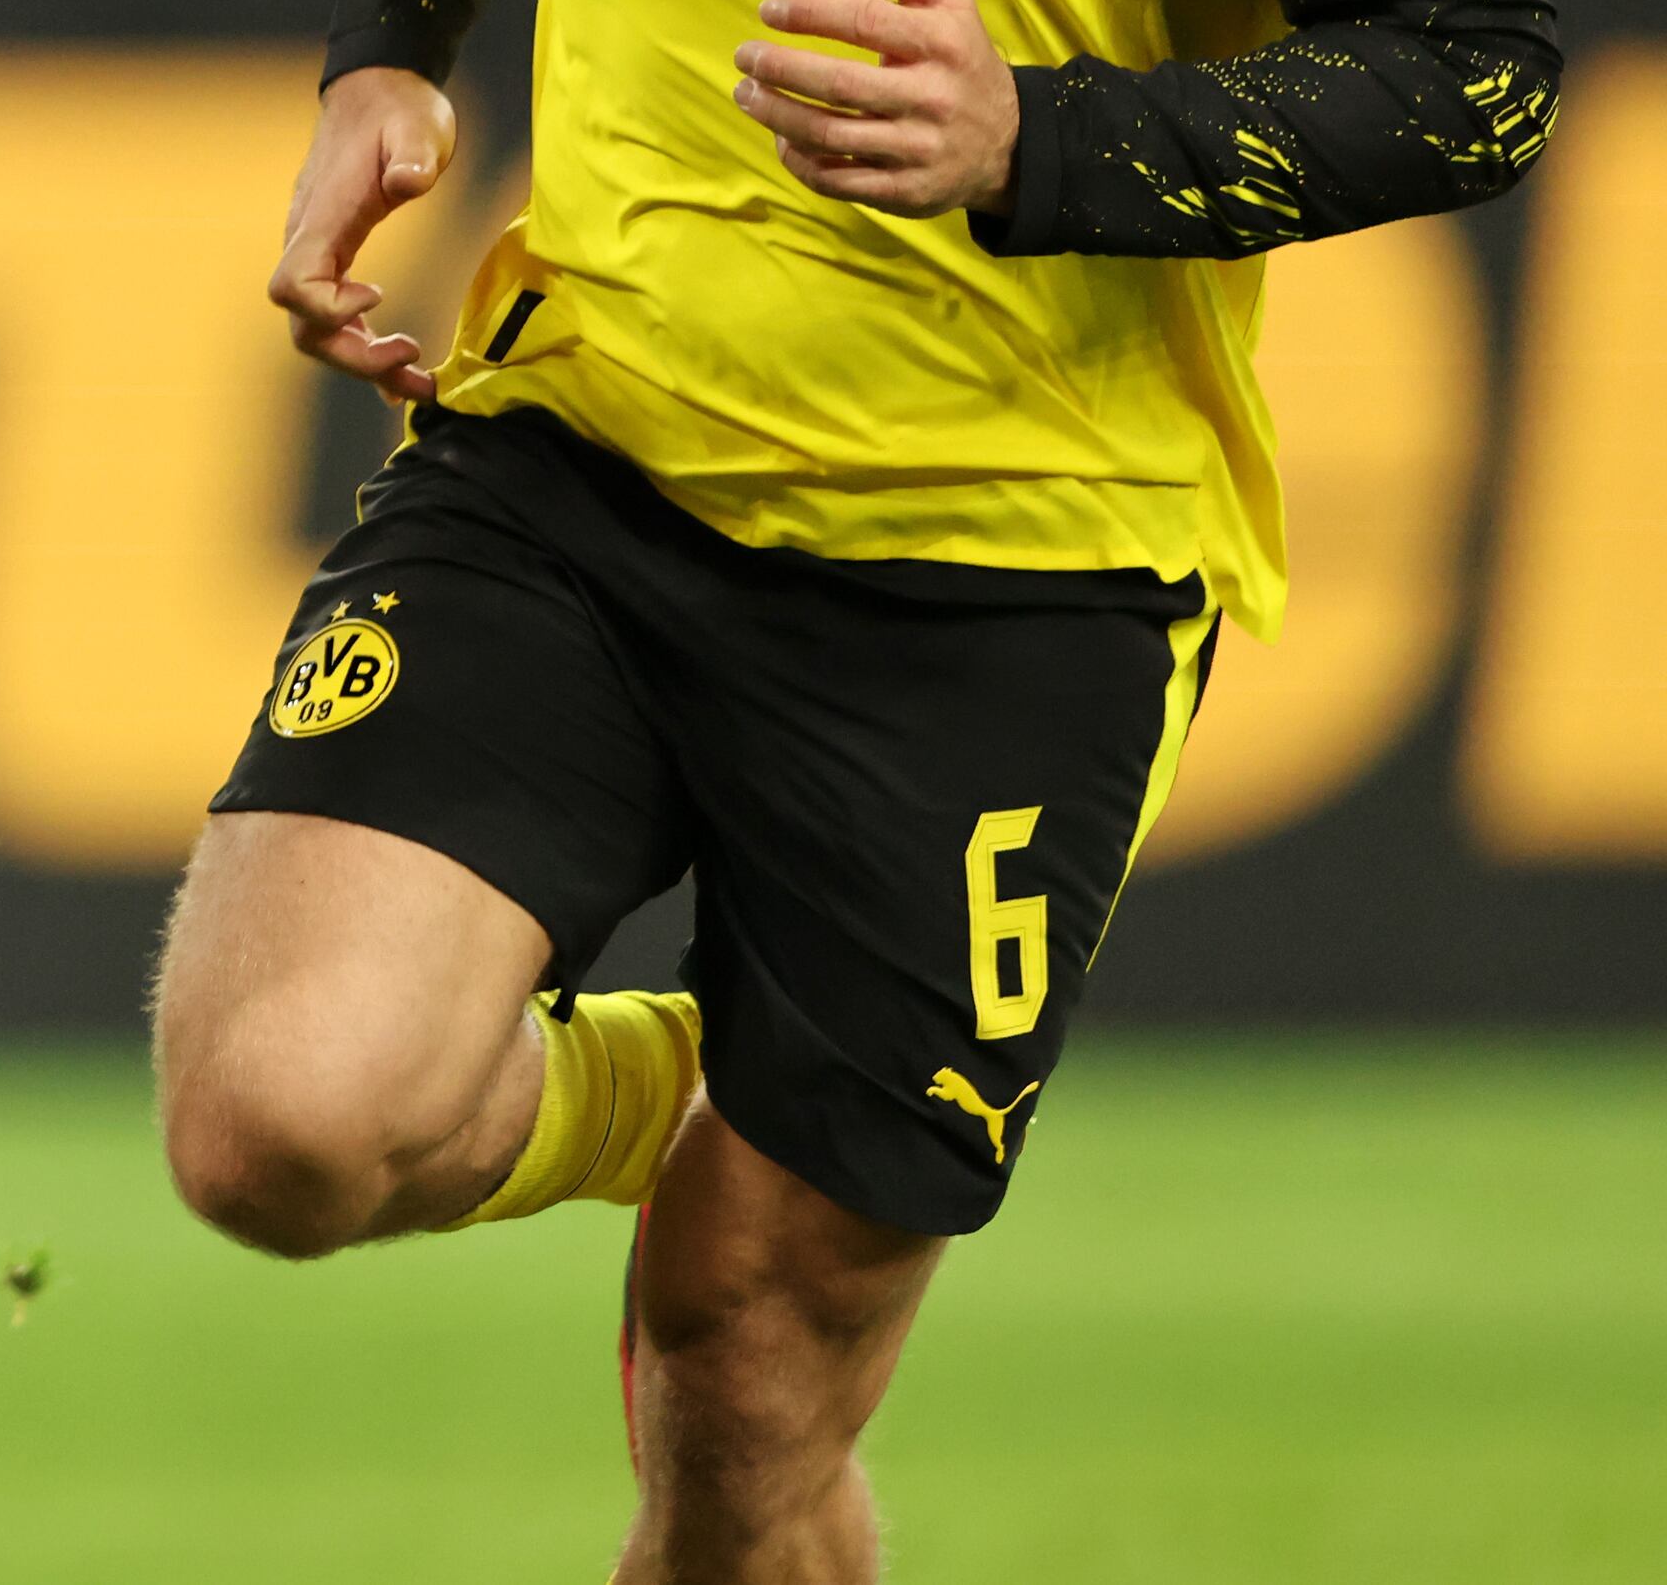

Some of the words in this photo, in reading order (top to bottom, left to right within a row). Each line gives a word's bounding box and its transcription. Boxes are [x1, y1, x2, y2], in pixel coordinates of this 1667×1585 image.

[282, 632, 381, 711] BVB
[298, 698, 334, 724] 09
[964, 805, 1049, 1040] 6
